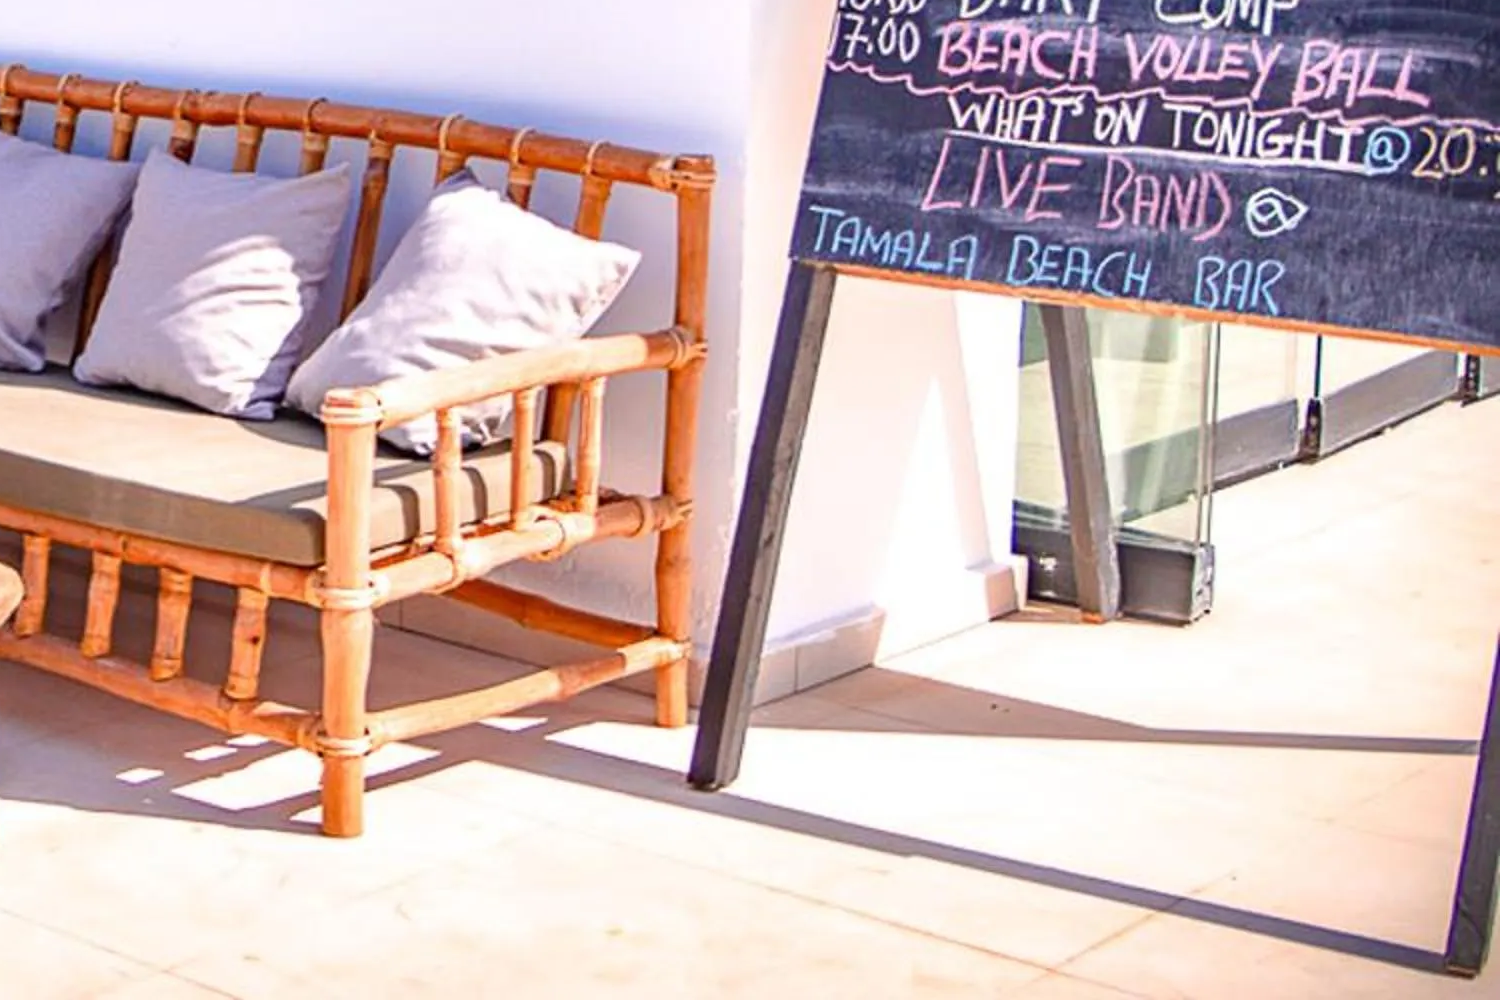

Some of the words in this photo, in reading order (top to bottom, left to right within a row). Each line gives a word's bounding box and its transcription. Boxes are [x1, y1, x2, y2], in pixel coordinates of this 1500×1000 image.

[936, 20, 1098, 79] BEACH
[1123, 28, 1284, 102] VOLLEY
[1291, 37, 1431, 108] BALL
[1094, 98, 1149, 146] ON
[1162, 102, 1366, 166] TONIGHT
[920, 137, 1083, 222] LIVE
[1099, 154, 1233, 242] BAND
[808, 205, 979, 281] TAMALA
[1005, 235, 1153, 298] BEACH
[1194, 255, 1286, 315] BAR
